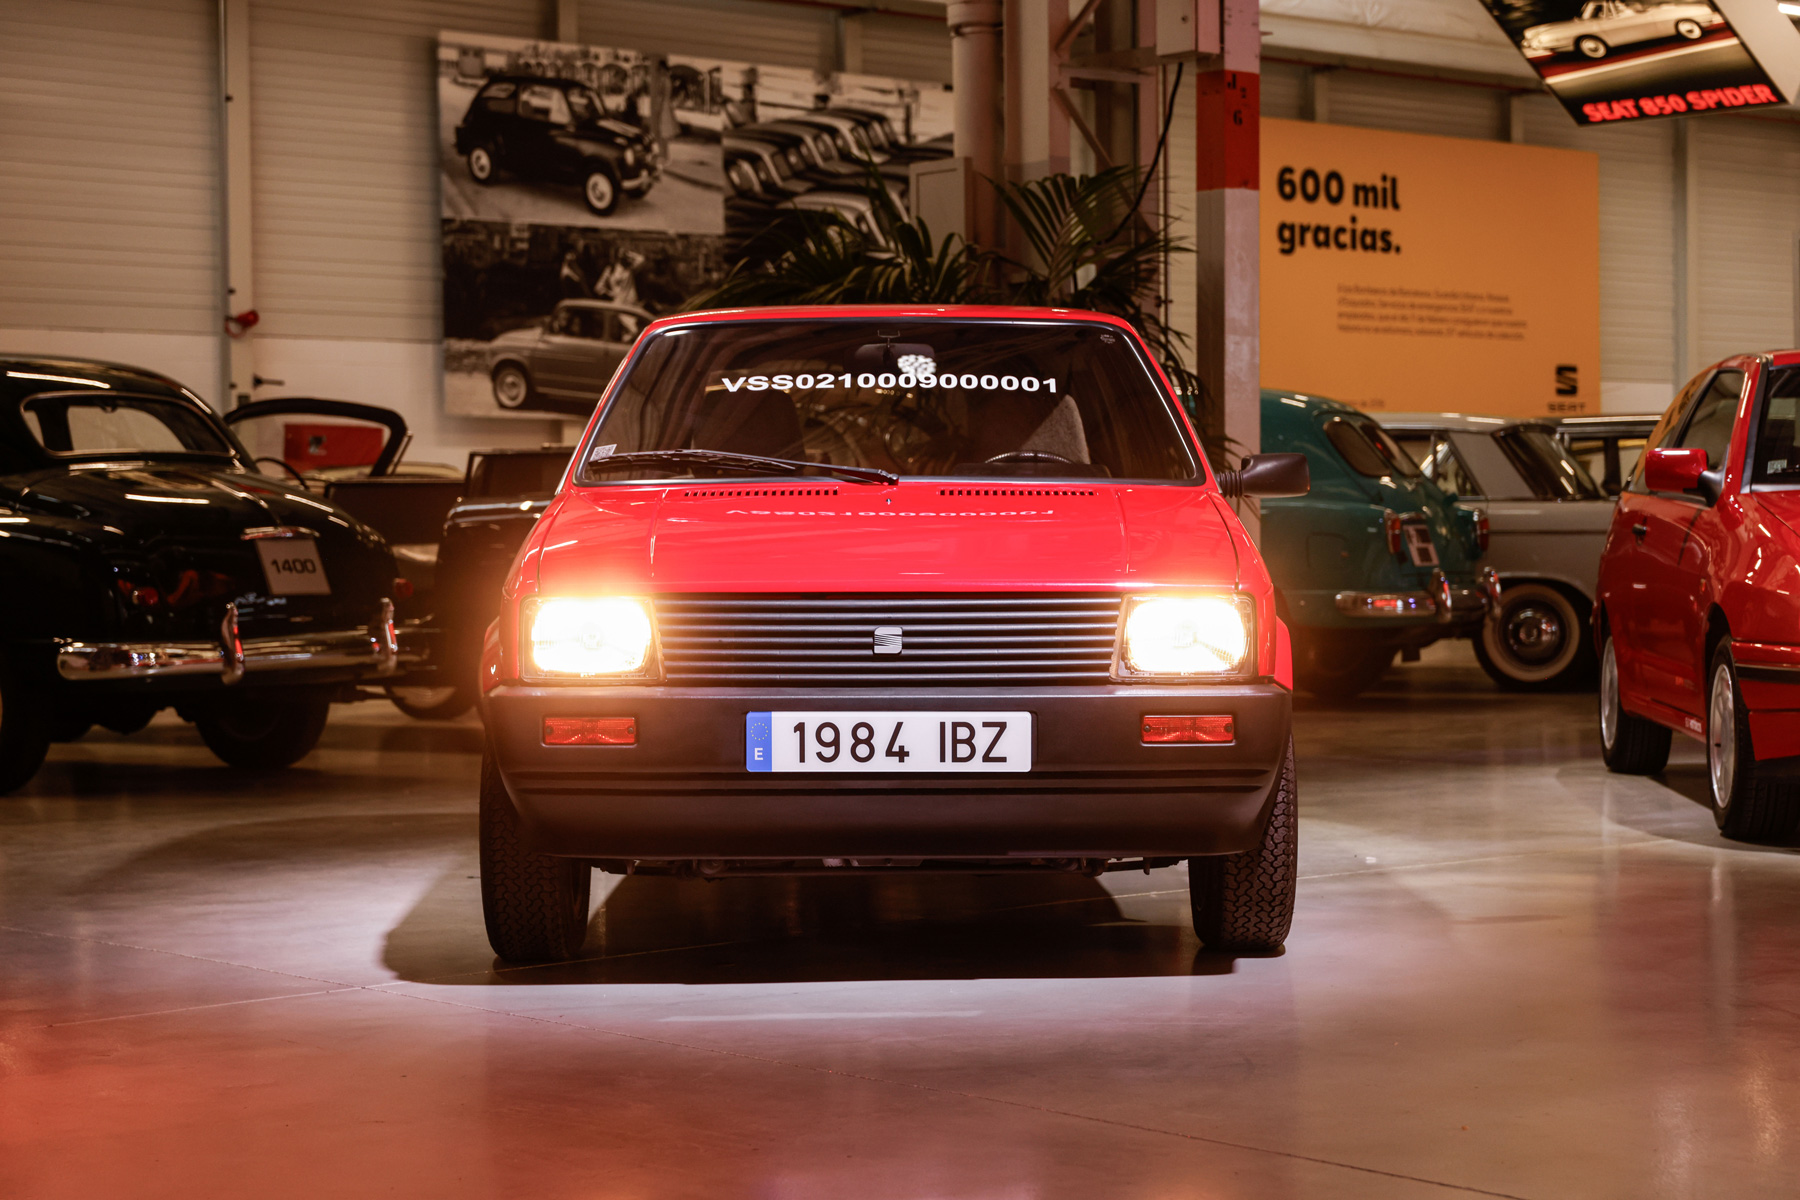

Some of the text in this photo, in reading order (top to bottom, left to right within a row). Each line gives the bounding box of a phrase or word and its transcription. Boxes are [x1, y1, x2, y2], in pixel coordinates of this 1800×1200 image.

[1582, 83, 1779, 122] SEAT 850 SPIDER
[1277, 166, 1401, 211] 600 mil
[1277, 215, 1402, 255] gracias.
[721, 373, 1057, 393] VSS0210009000001
[1548, 402, 1586, 413] SEAT
[271, 558, 317, 574] 1400
[754, 748, 764, 761] E
[793, 721, 1007, 763] 1984 IBZ
